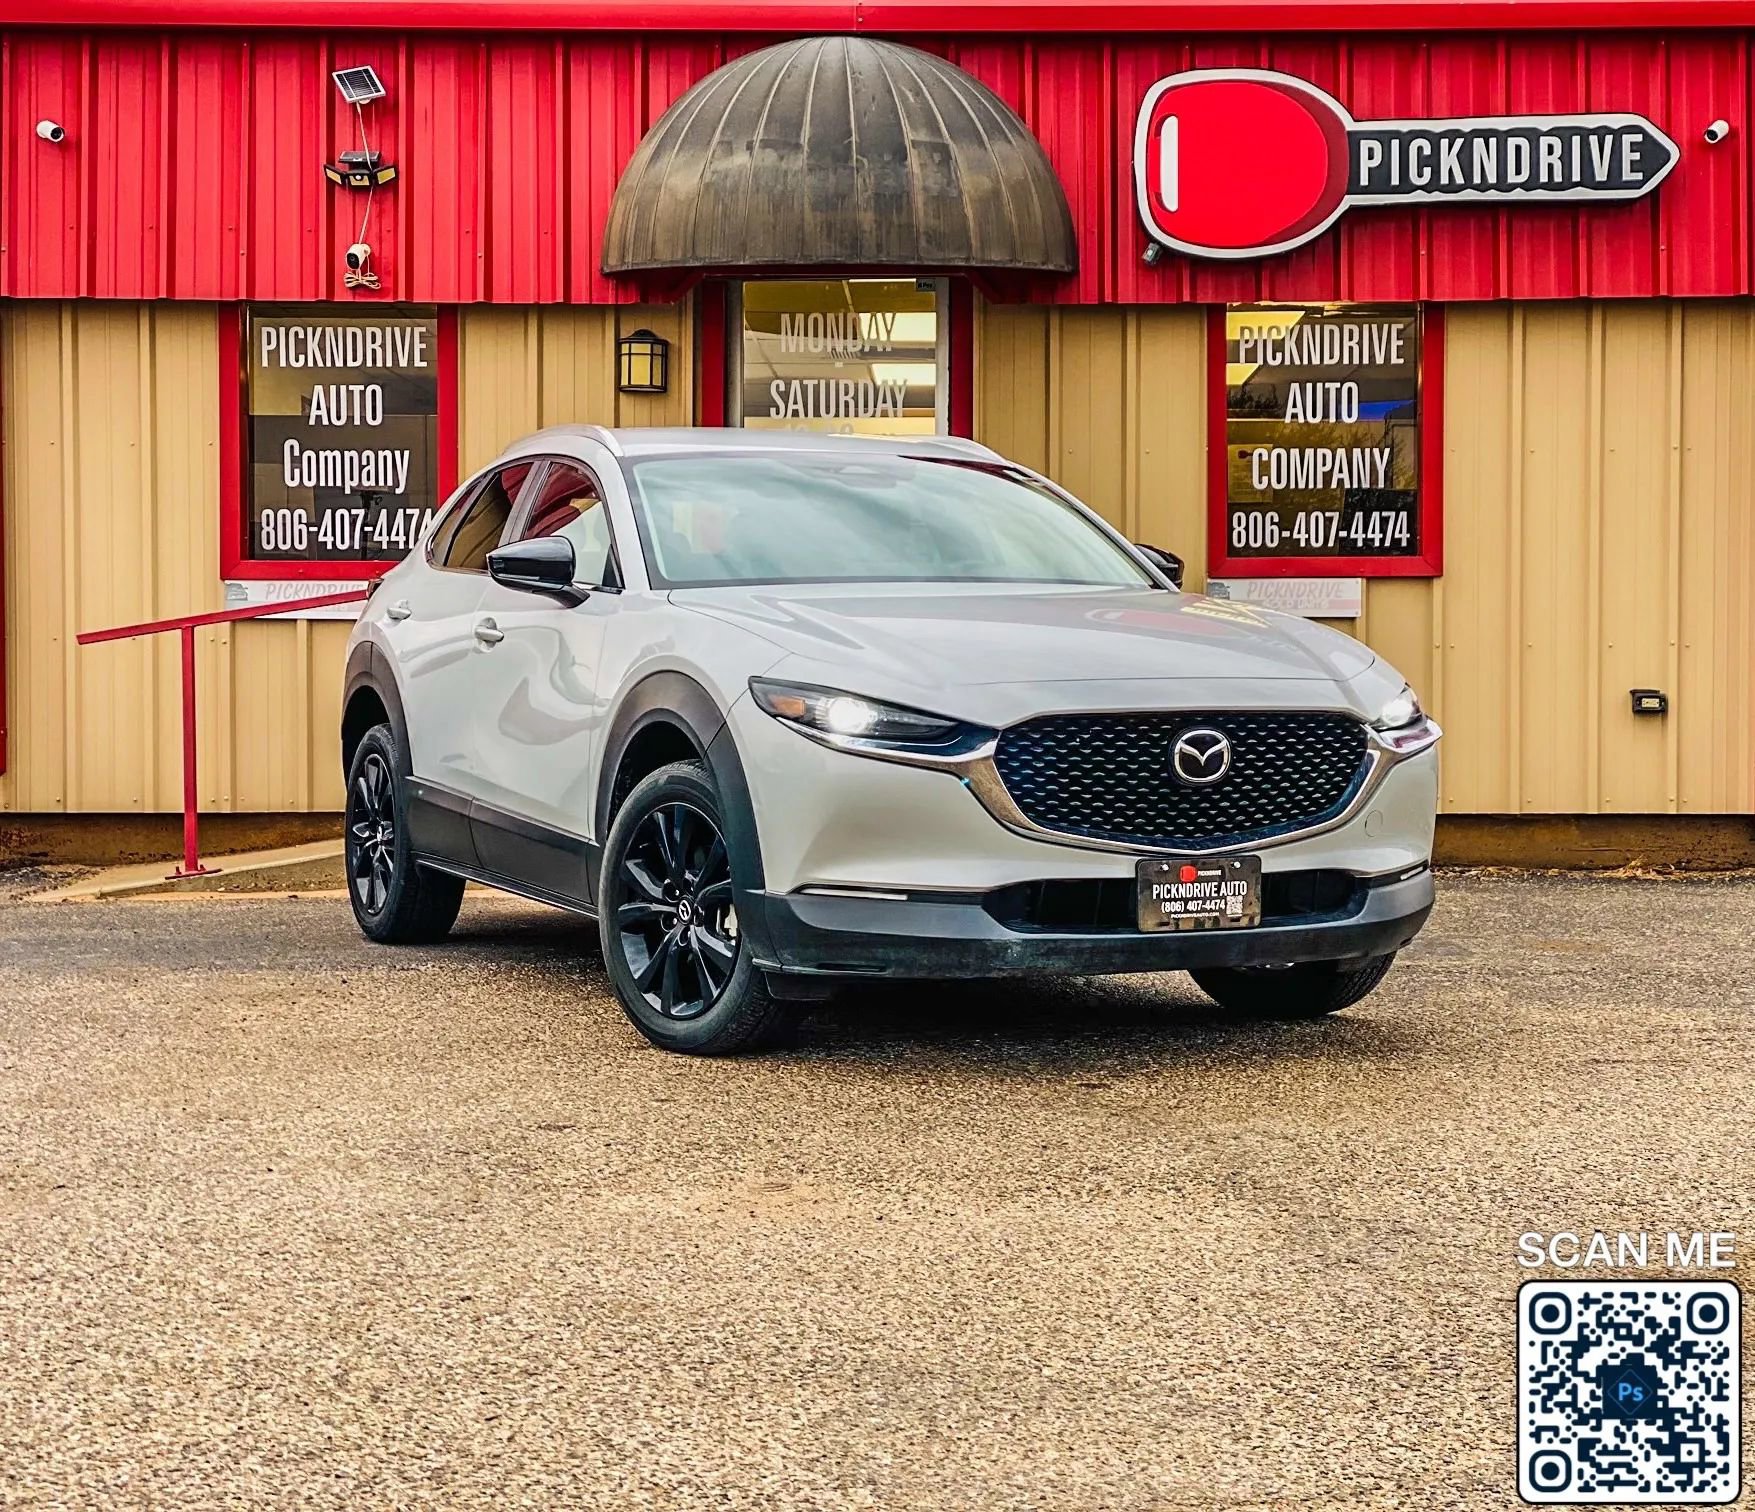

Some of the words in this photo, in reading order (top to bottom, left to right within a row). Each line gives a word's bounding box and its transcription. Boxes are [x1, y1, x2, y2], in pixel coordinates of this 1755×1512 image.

[1358, 133, 1645, 188] PICKNDRIVE
[260, 326, 428, 368] PICKNDRIVE
[780, 312, 896, 353] MONDAY
[1238, 323, 1404, 366] PICKNDRIVE
[308, 384, 384, 426] AUTO
[769, 379, 908, 420] SATURDAY
[1284, 382, 1359, 424] AUTO
[283, 438, 410, 495] Company
[1252, 447, 1390, 490] COMPANY
[1232, 511, 1410, 548] 806-407-4474
[1247, 581, 1344, 599] PICKNDRIVE
[1152, 882, 1218, 900] PICKNDRIVE
[1220, 881, 1247, 896] AUTO
[1161, 901, 1184, 913] (806)
[1187, 899, 1225, 911] 407-4474
